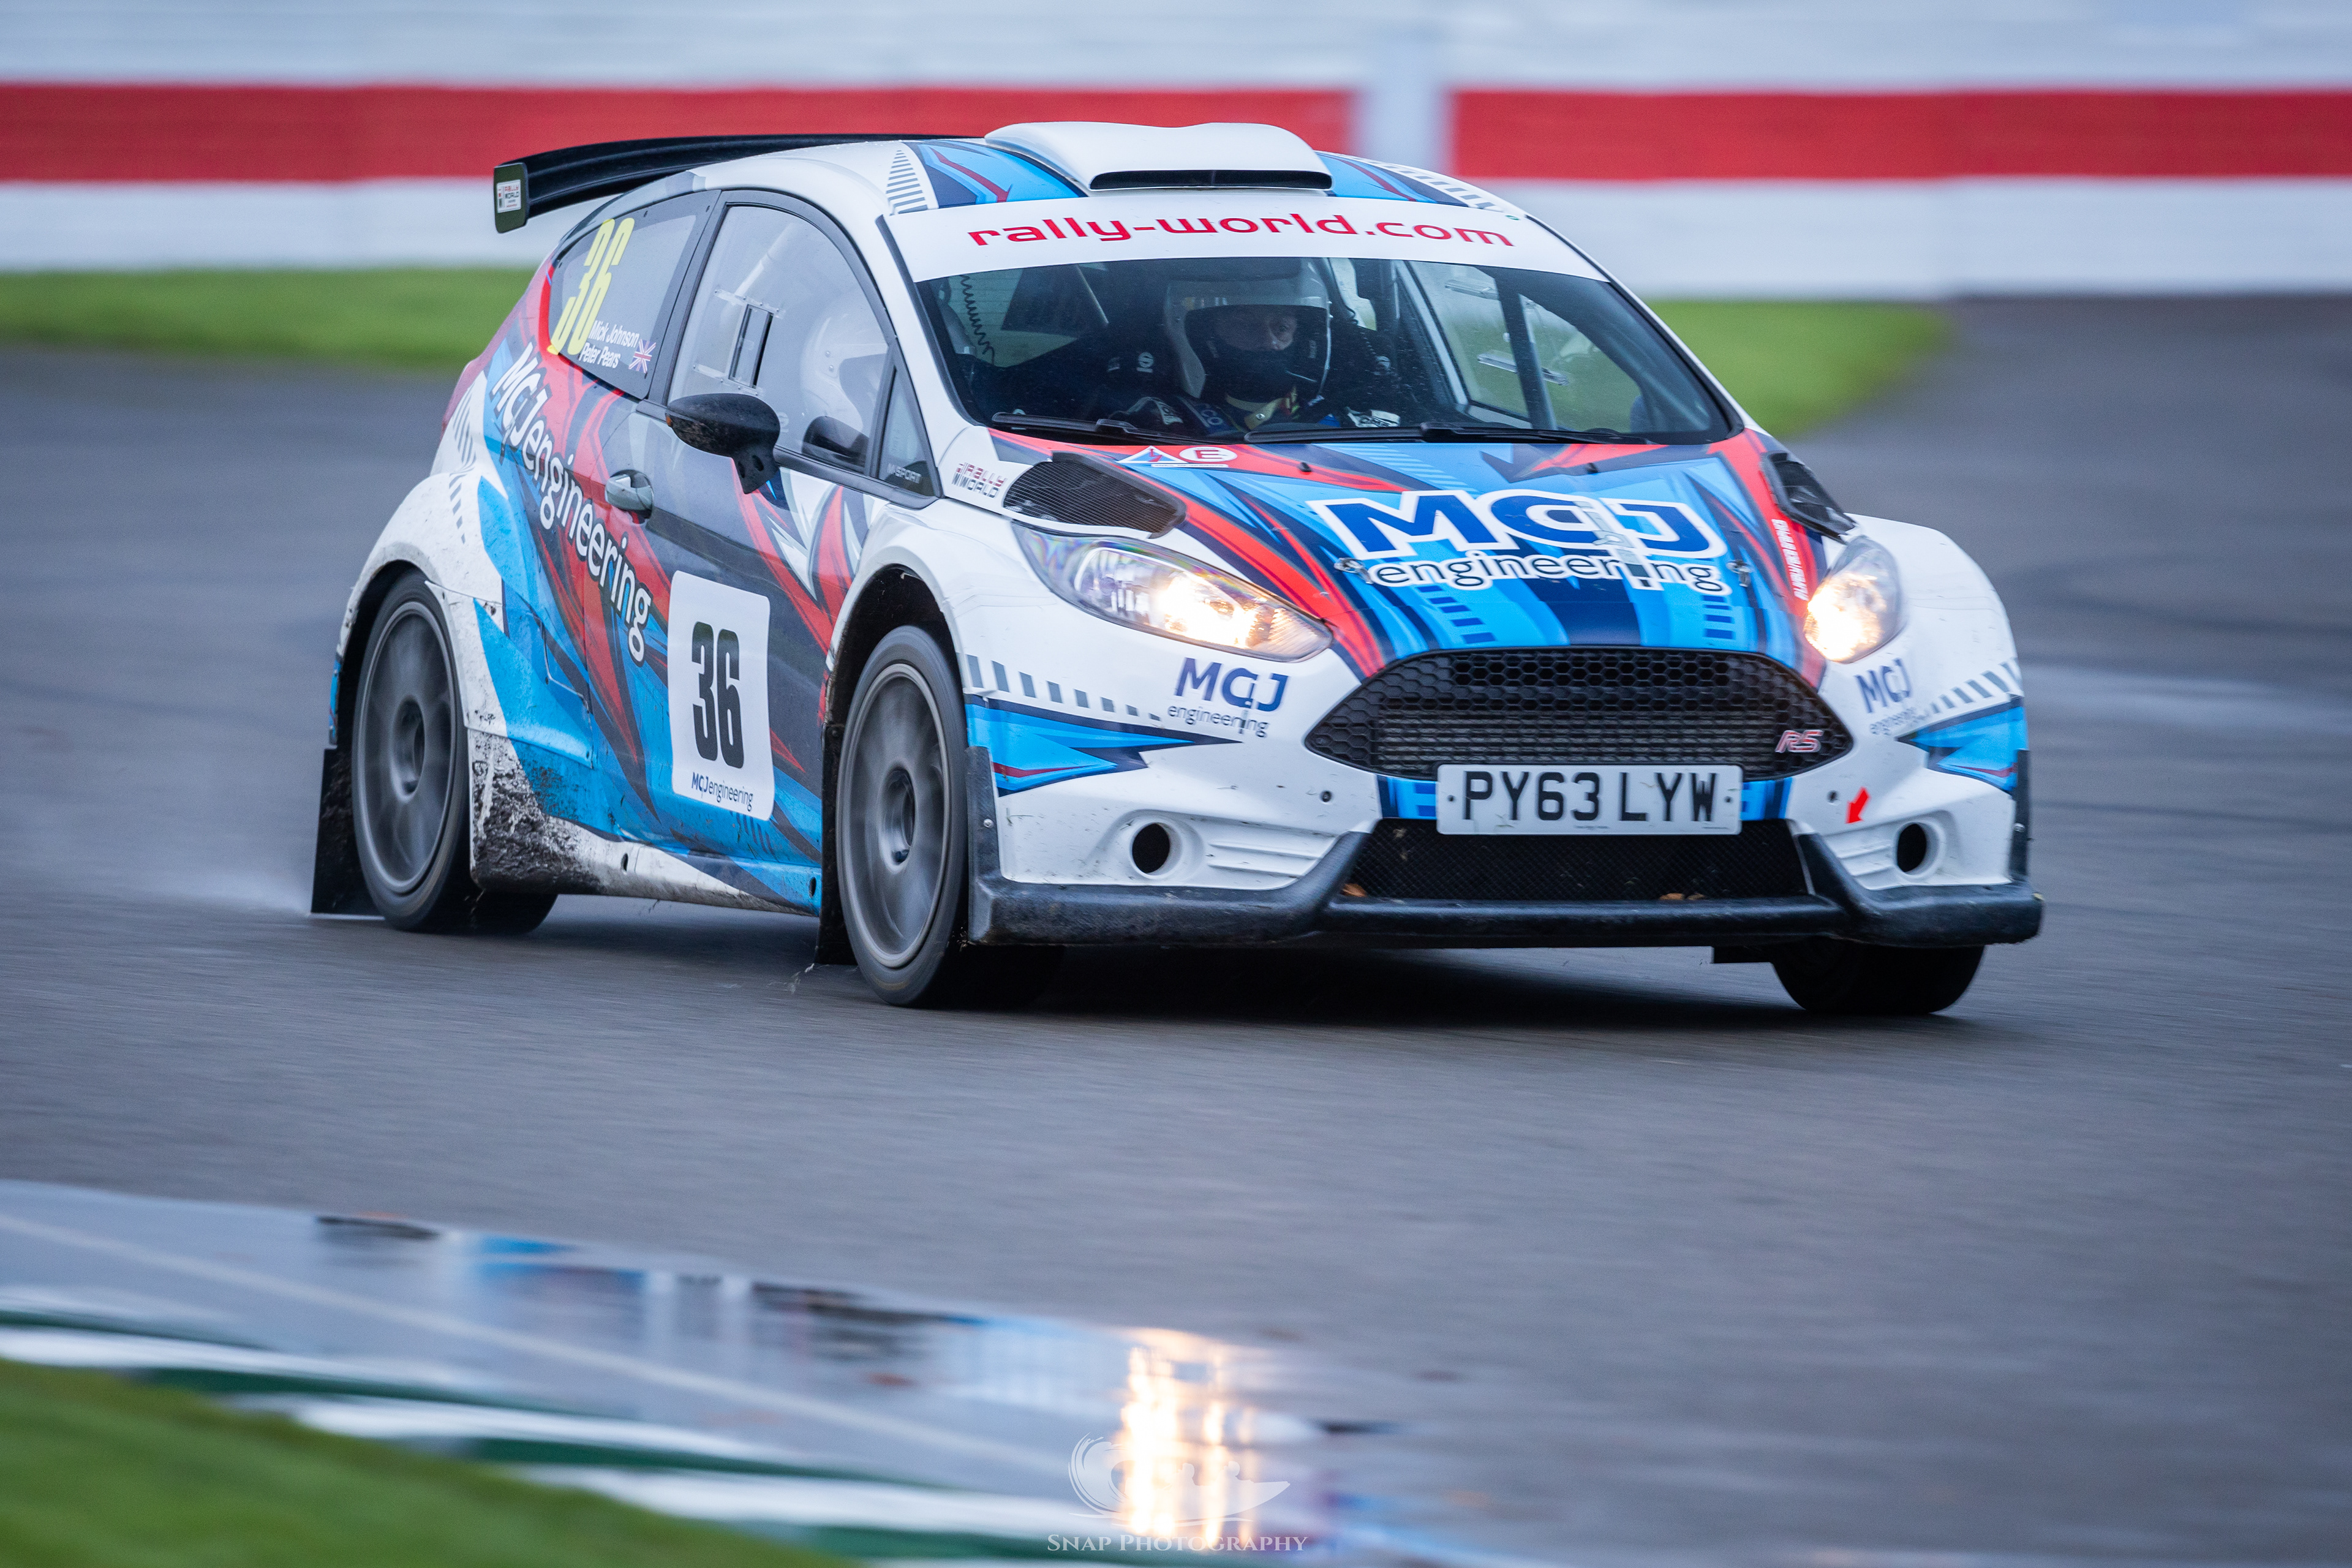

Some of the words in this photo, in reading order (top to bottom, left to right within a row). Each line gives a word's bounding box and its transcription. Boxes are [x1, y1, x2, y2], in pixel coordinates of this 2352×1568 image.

[968, 213, 1514, 247] rally-world.com
[547, 217, 635, 355] 36
[578, 342, 601, 364] Peter
[597, 346, 620, 369] Pears
[588, 320, 609, 341] Mick
[606, 324, 639, 348] Johnson
[1310, 489, 1725, 558] MCJ
[1373, 551, 1730, 594] engineering
[691, 620, 745, 769] 36
[1174, 657, 1290, 712] MCJ
[1853, 657, 1912, 714] MCJ
[1168, 705, 1270, 738] engineering
[1775, 729, 1824, 753] RS
[1464, 771, 1600, 821] PY63
[1619, 771, 1717, 822] LYW
